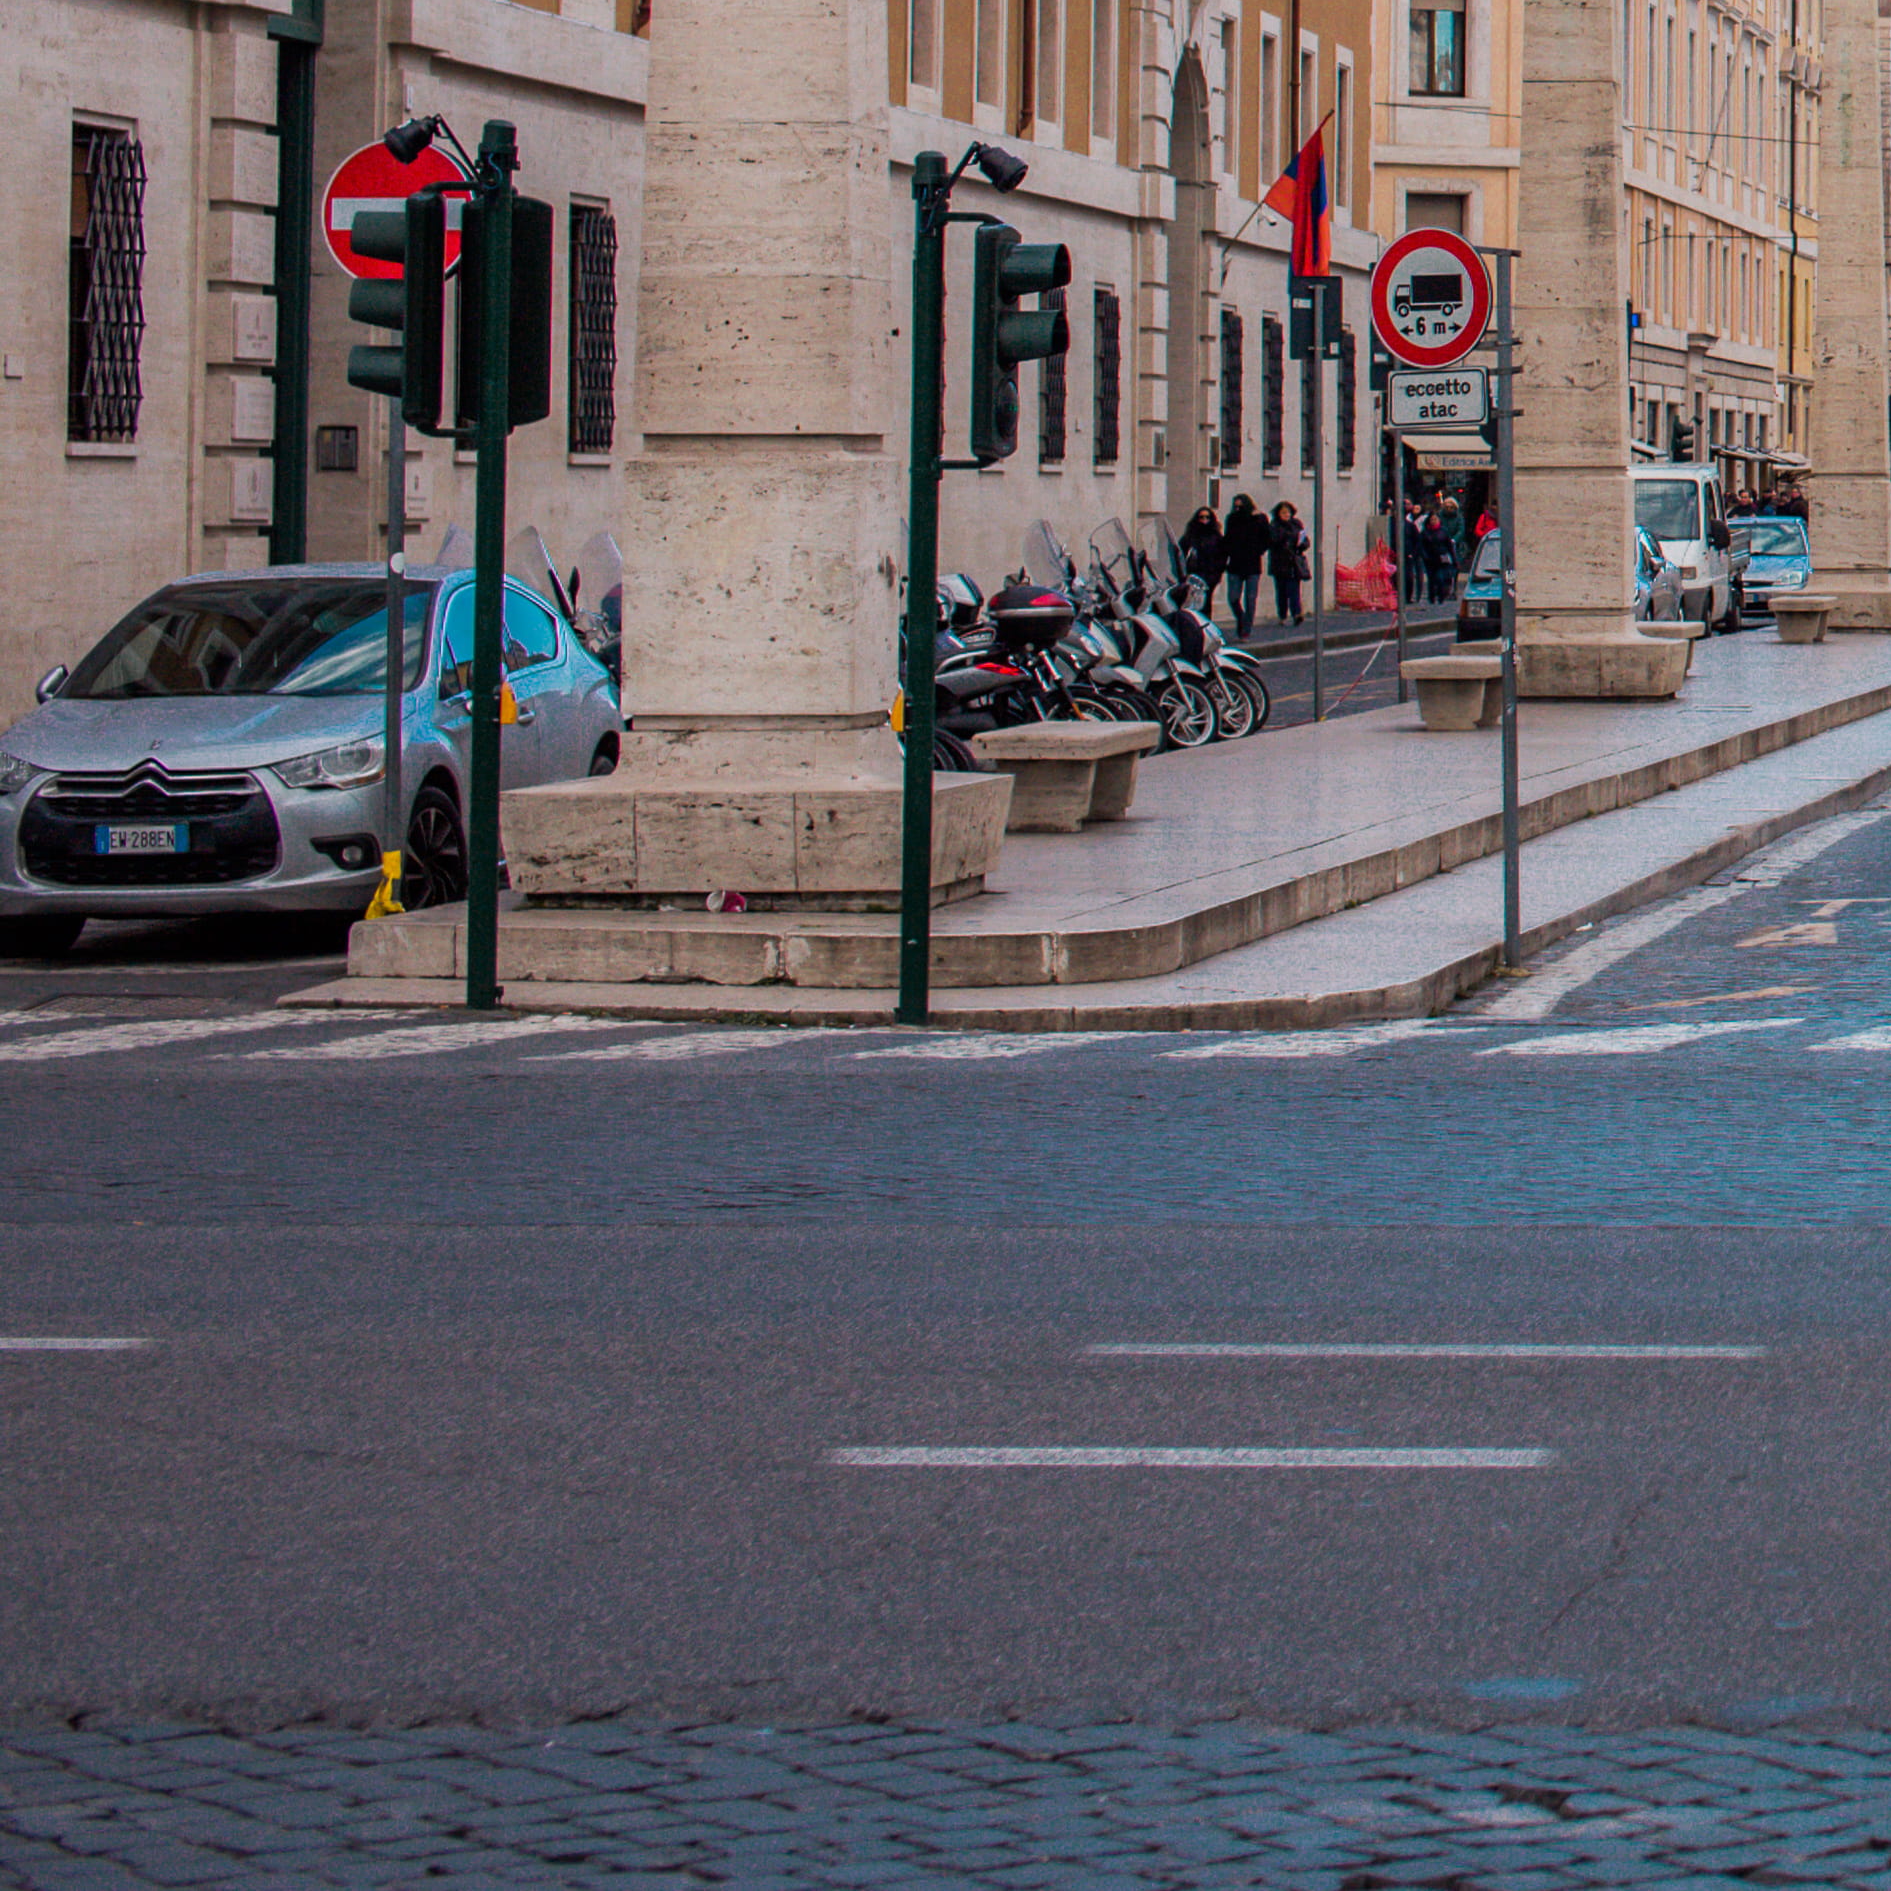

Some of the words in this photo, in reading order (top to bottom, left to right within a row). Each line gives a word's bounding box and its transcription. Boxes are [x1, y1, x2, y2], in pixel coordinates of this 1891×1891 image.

[1416, 316, 1426, 336] 6
[1433, 321, 1446, 335] m
[1405, 378, 1471, 398] eccetto
[1419, 401, 1459, 418] atac
